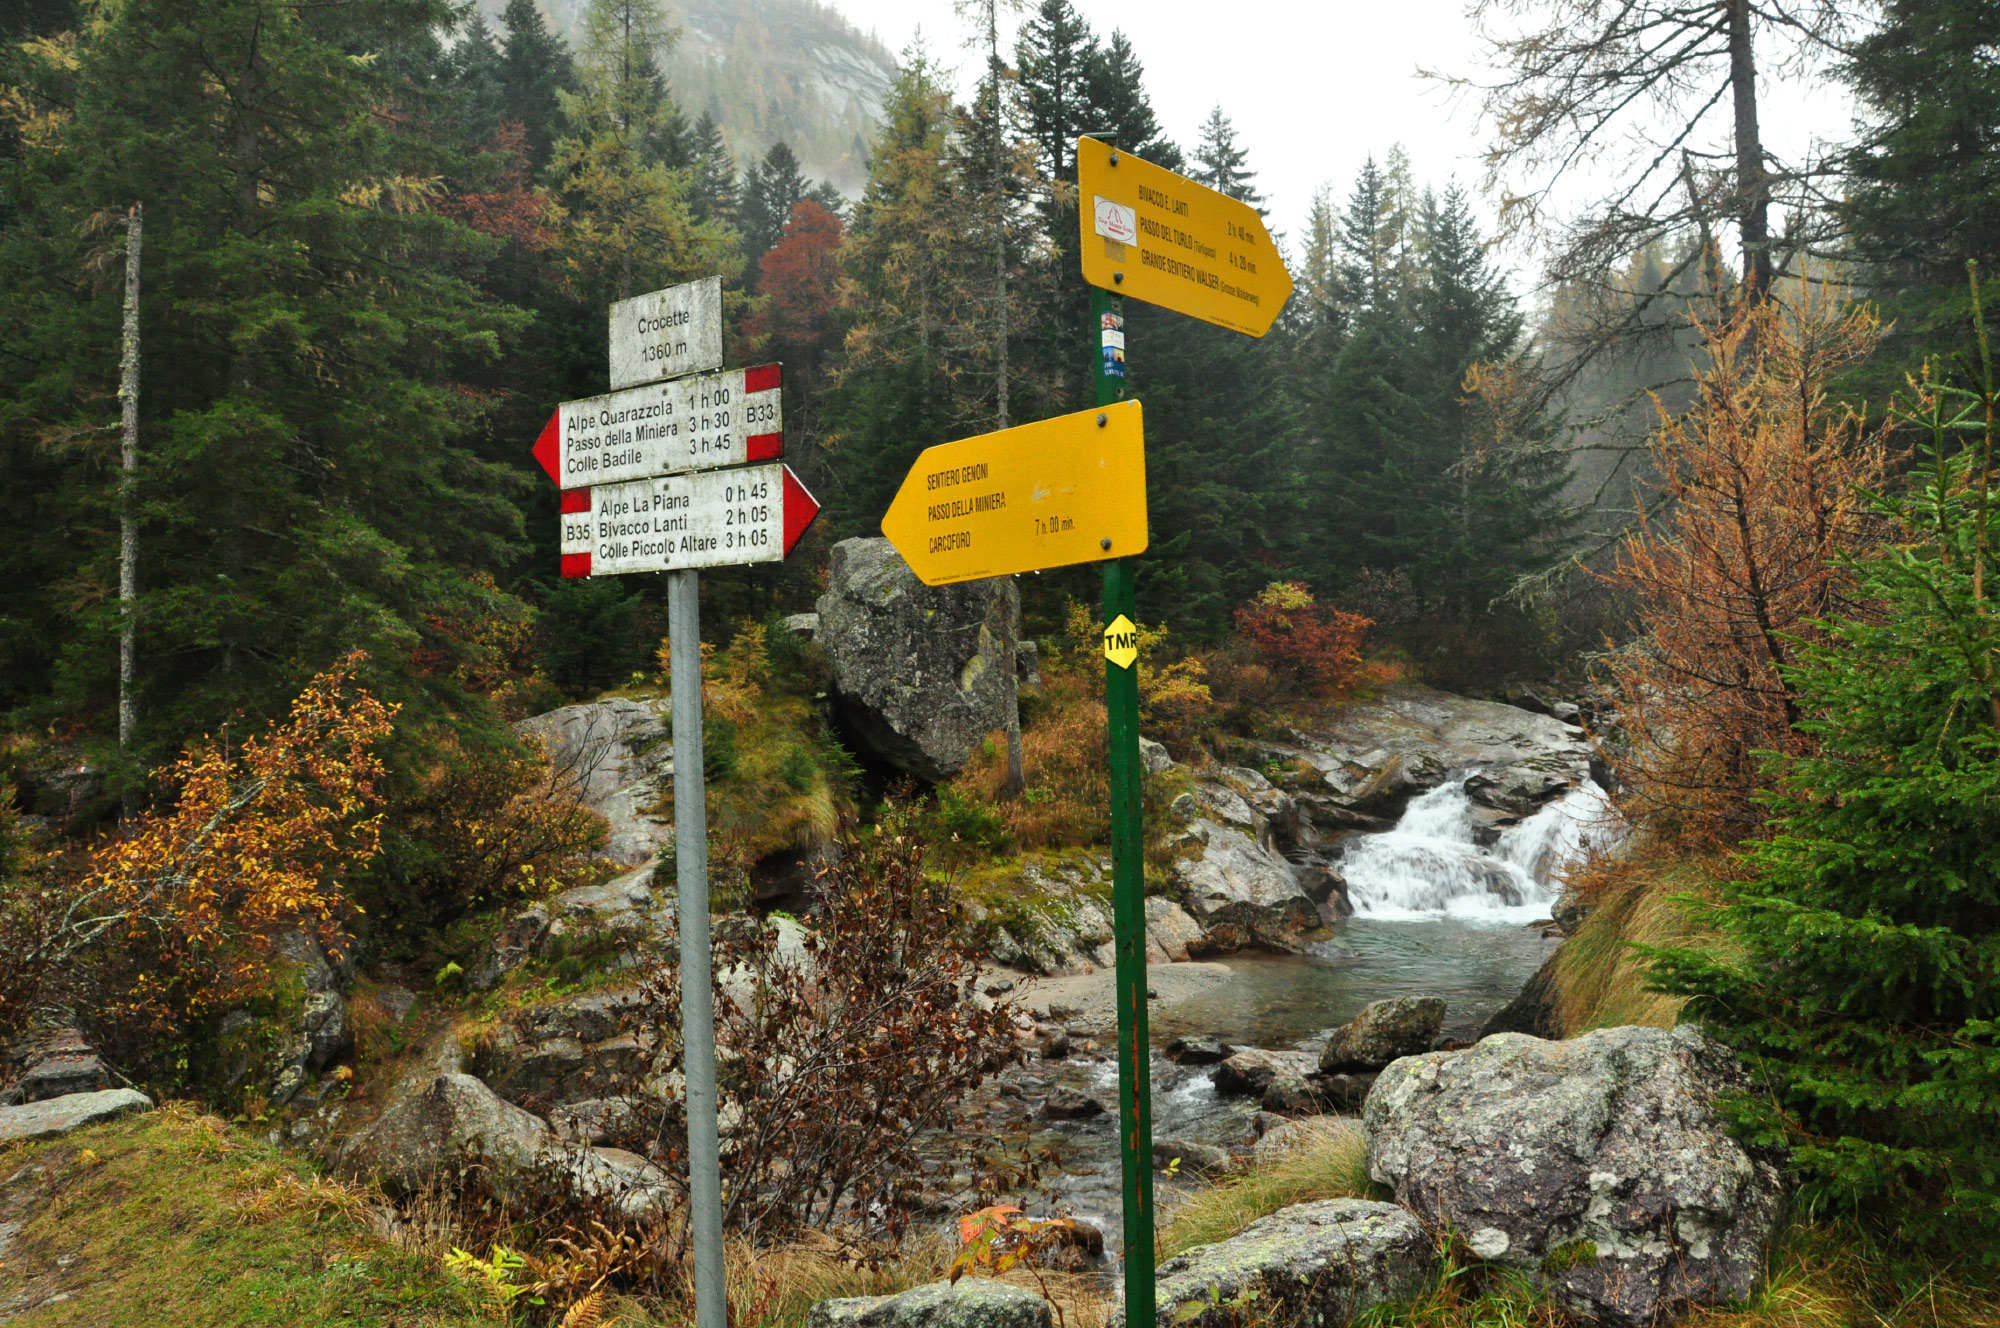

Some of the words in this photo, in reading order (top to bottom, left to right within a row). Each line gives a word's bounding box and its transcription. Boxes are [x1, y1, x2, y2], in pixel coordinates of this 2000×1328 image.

[1138, 184, 1164, 208] BIVACCO
[1165, 195, 1170, 211] E.
[1172, 198, 1189, 218] LANTI
[1238, 226, 1245, 240] 40
[1140, 216, 1160, 238] PASSO
[1161, 224, 1172, 243] DEL
[1173, 229, 1192, 250] TURLO
[1240, 256, 1246, 270] 20
[1141, 249, 1166, 272] GRANDE
[1167, 258, 1195, 282] SENTIERO
[1196, 268, 1219, 291] WALSER
[638, 310, 690, 334] Crocette
[642, 343, 671, 362] 1360
[676, 342, 687, 355] m
[567, 415, 596, 434] Alpe
[600, 400, 673, 426] Quarazzola
[689, 394, 694, 411] 1
[702, 394, 708, 408] h
[714, 388, 730, 406] 00
[747, 404, 774, 423] B33
[567, 436, 600, 453] Passo
[605, 429, 632, 447] della
[636, 423, 678, 442] Miniera
[689, 417, 696, 432] 3
[702, 415, 708, 430] h
[714, 411, 730, 428] 30
[568, 456, 598, 473] Colle
[603, 449, 642, 468] Badile
[690, 439, 696, 454] 3
[702, 437, 709, 453] h
[715, 434, 730, 450] 45
[927, 468, 959, 491] SENTIERO
[962, 463, 988, 483] GENONI
[600, 500, 629, 519] Alpe
[634, 497, 648, 512] La
[654, 494, 689, 511] Piana
[726, 487, 732, 502] 0
[738, 485, 745, 502] h
[751, 483, 767, 499] 45
[928, 502, 950, 522] PASSO
[952, 498, 974, 518] DELLA
[975, 492, 1006, 512] MINIERA
[1035, 519, 1039, 536] 7
[1050, 516, 1059, 533] 00
[1062, 516, 1075, 531] min.
[567, 525, 590, 540] B35
[600, 521, 649, 538] Bivacco
[654, 514, 687, 532] Lanti
[726, 509, 733, 525] 2
[739, 508, 746, 524] h
[751, 506, 767, 522] 05
[600, 542, 628, 559] Colle
[632, 538, 675, 556] Piccolo
[680, 536, 717, 552] Altare
[726, 532, 733, 548] 3
[739, 531, 746, 547] h
[751, 529, 767, 546] 05
[929, 531, 970, 554] CARCOFORO
[1105, 632, 1136, 650] TMR
